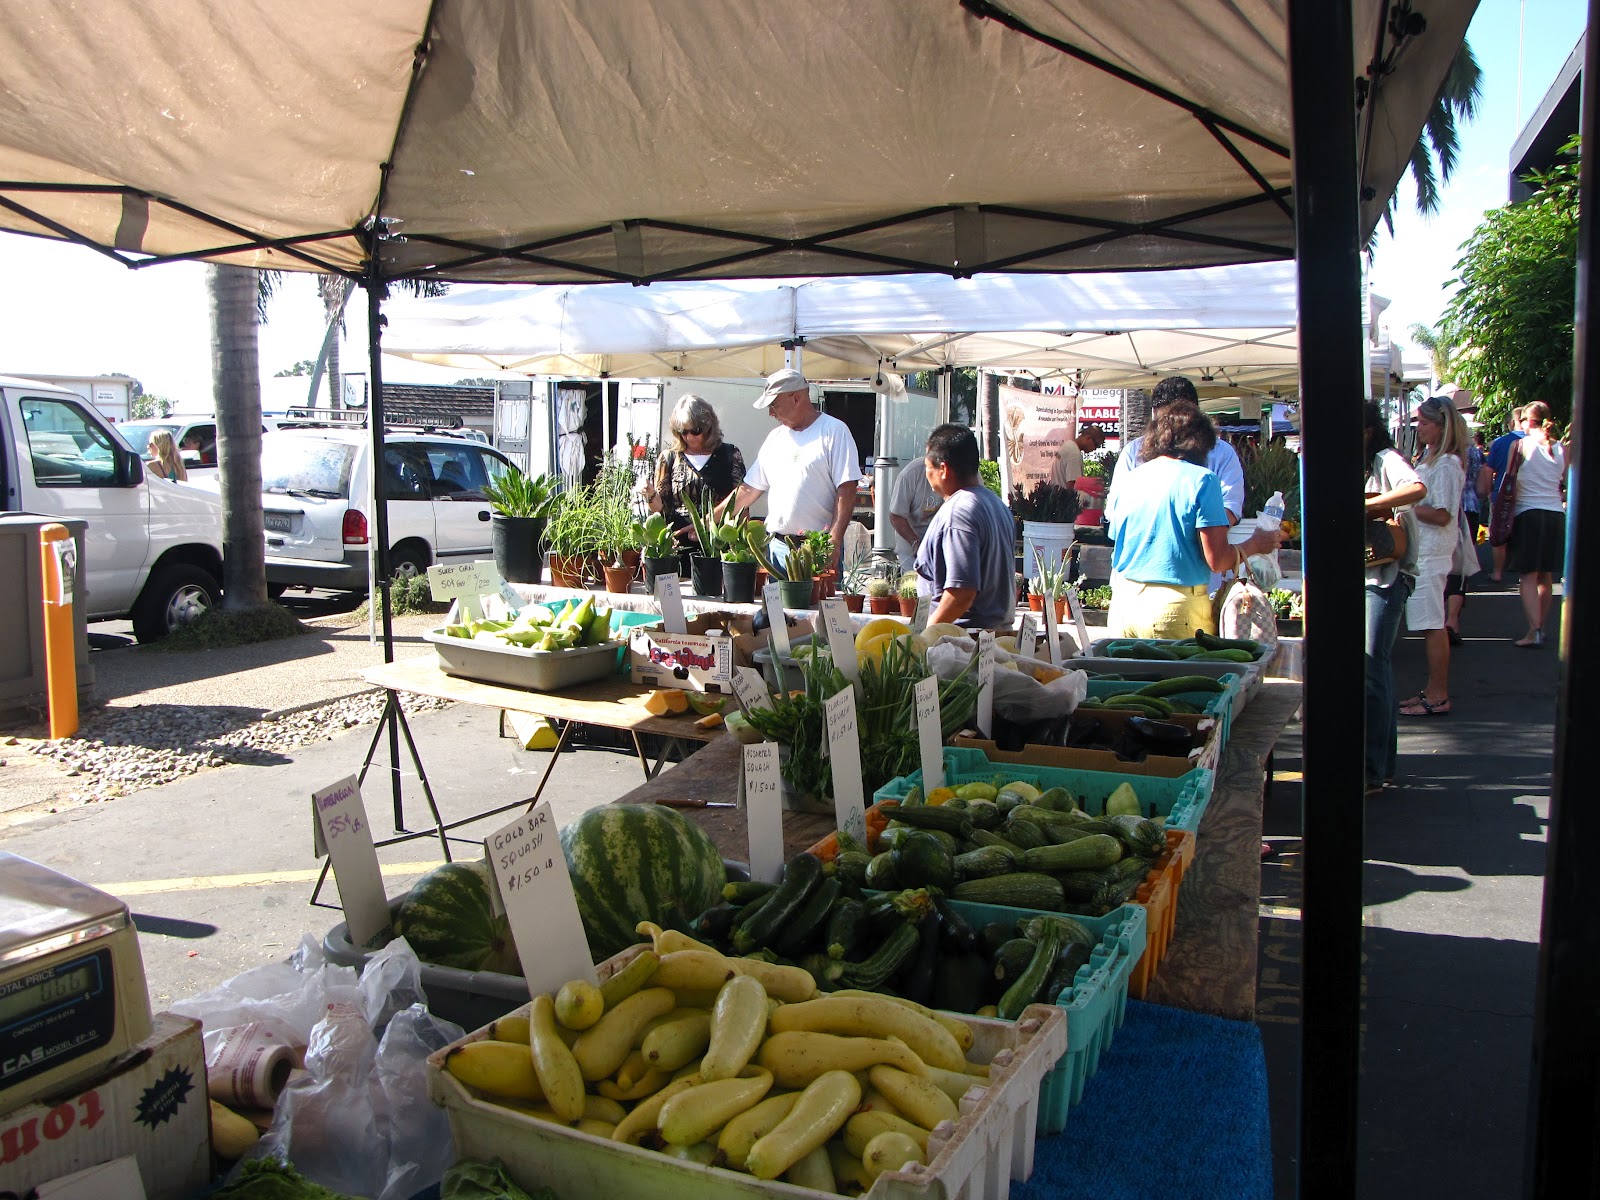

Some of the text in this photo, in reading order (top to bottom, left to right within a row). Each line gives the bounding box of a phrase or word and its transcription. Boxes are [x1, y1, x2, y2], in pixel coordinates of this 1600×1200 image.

[1044, 384, 1065, 396] NAI
[494, 812, 548, 850] GOLD BAR
[500, 833, 543, 870] SQUASH
[25, 968, 56, 986] PRICE
[2, 1045, 44, 1075] CAS
